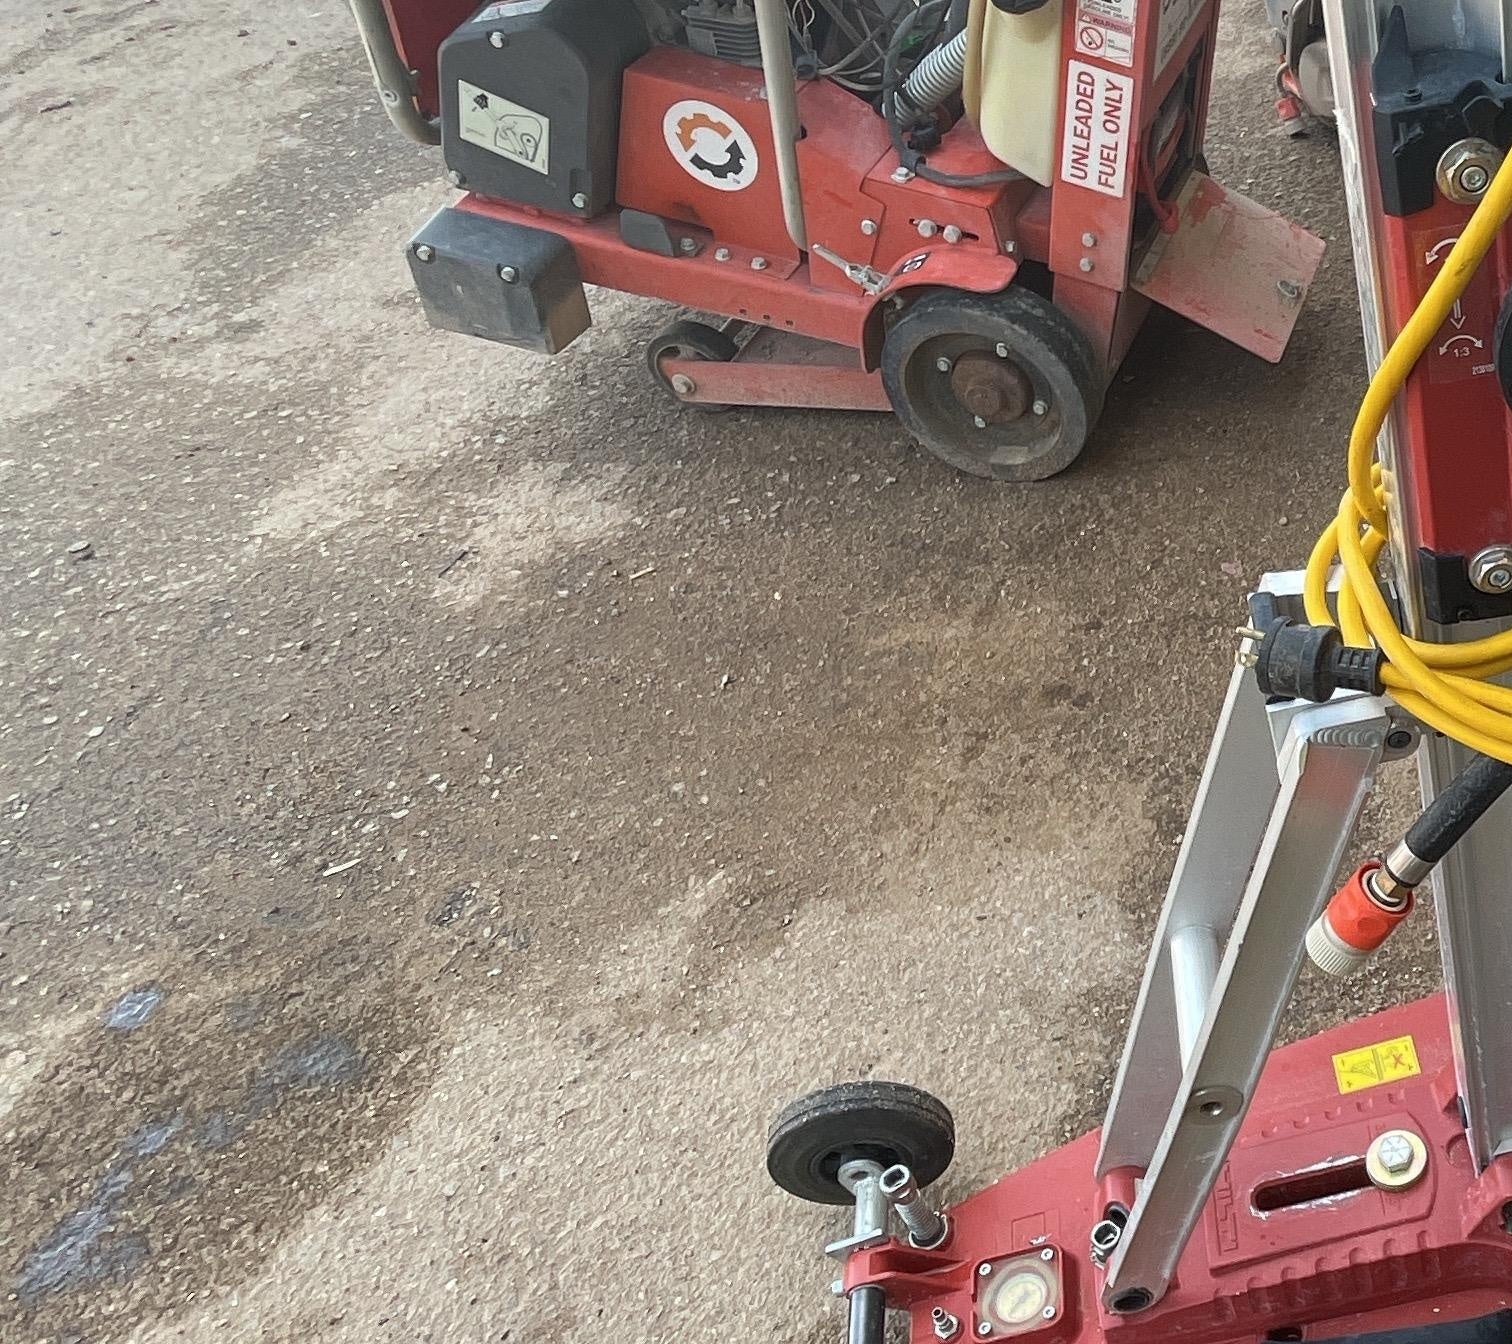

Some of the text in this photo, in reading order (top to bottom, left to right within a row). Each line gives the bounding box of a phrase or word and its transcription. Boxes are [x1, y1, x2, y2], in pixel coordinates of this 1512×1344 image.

[1092, 17, 1131, 34] WARNING
[1070, 70, 1095, 181] UNLEADED
[1102, 78, 1124, 135] ONLY
[1098, 141, 1119, 189] FUEL
